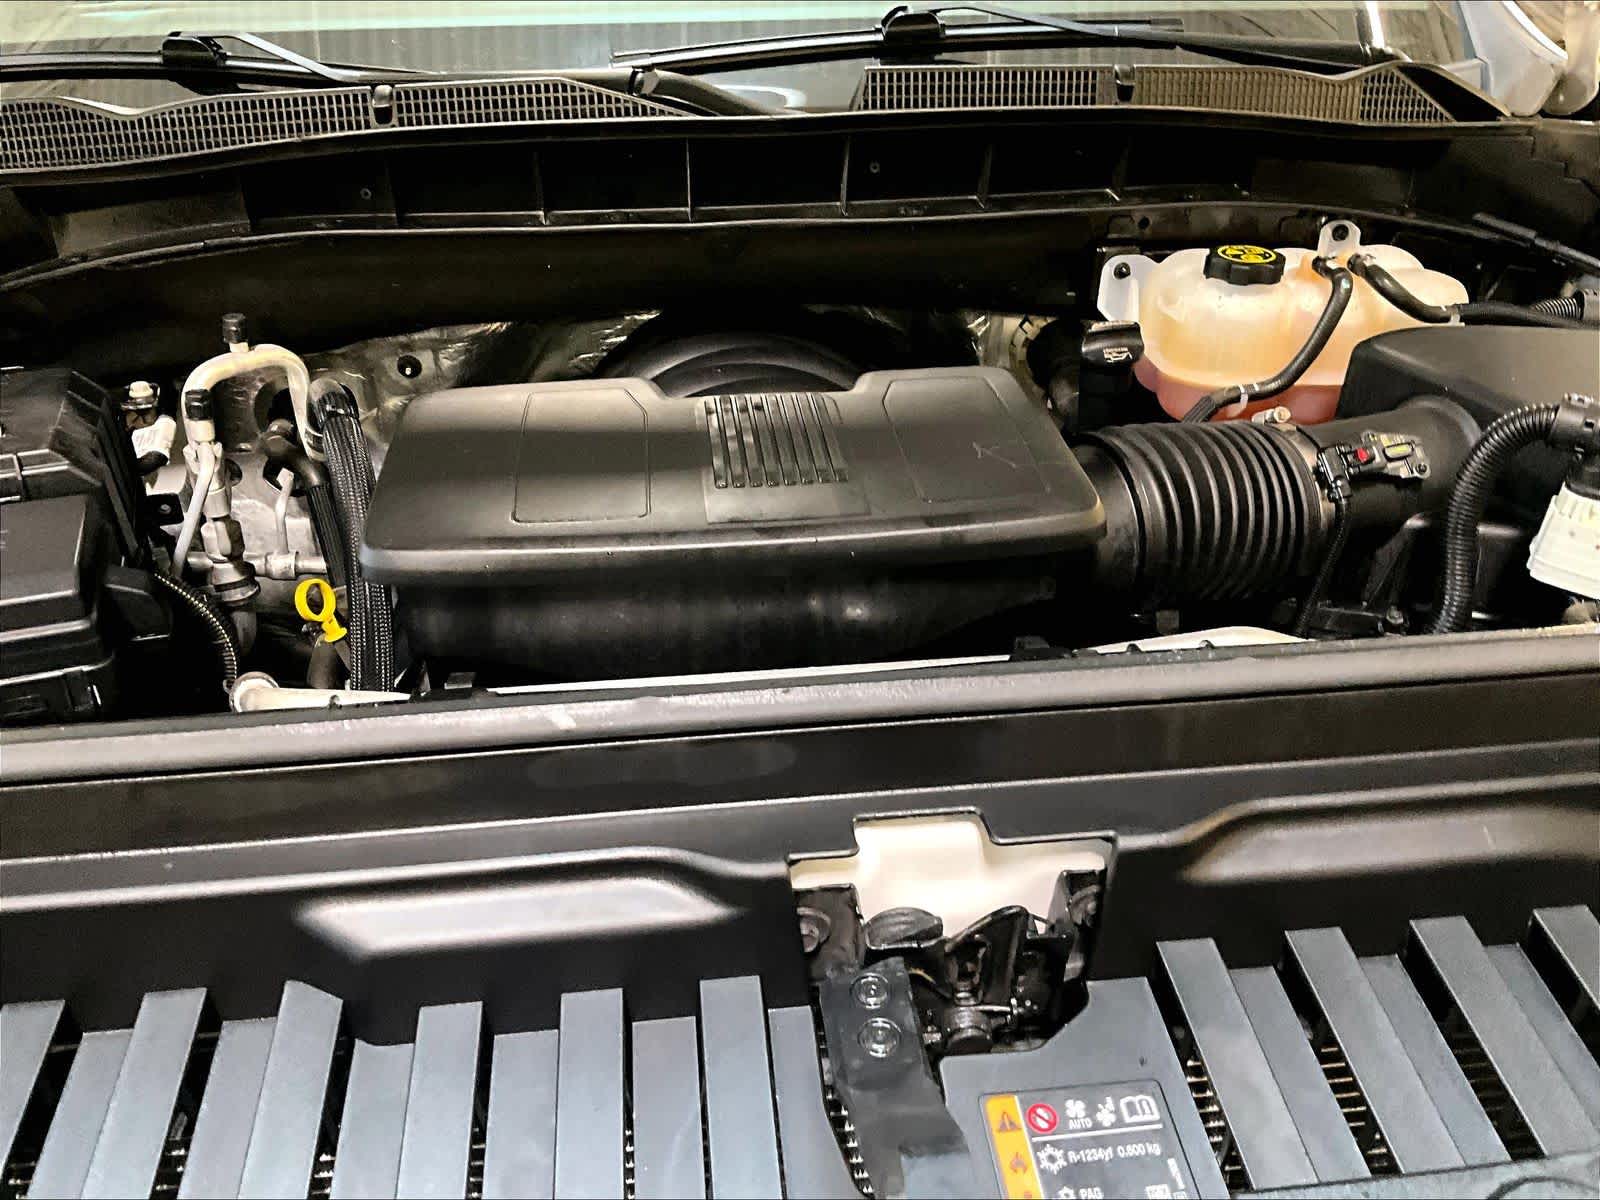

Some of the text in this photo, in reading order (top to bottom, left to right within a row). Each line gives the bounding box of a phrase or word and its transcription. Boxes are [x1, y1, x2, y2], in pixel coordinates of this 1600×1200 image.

[1069, 1117, 1092, 1129] AUTO
[1067, 1146, 1113, 1162] R-1234yf
[1146, 1142, 1161, 1156] kg
